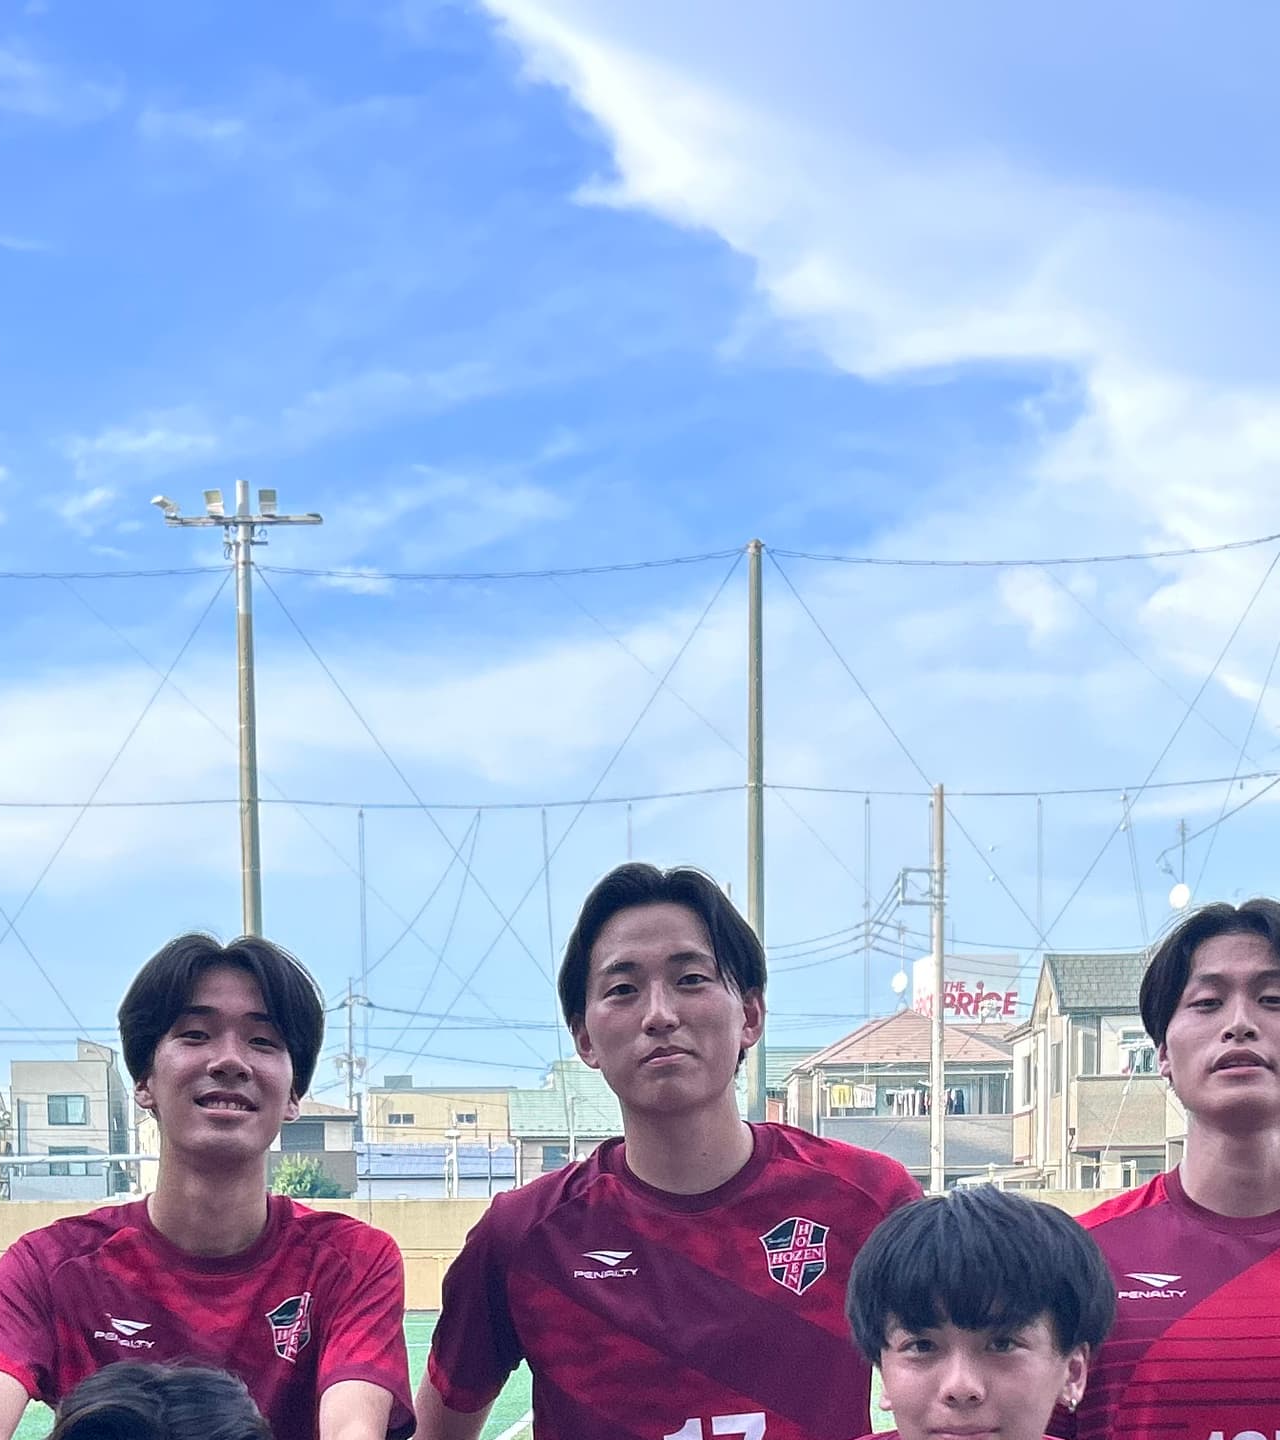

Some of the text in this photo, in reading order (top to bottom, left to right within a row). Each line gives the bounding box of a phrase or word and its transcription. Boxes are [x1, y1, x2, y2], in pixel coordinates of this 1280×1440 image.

[944, 981, 966, 992] THE
[772, 1248, 822, 1264] HOZEN
[574, 1268, 640, 1279] PENALTY
[1118, 1289, 1187, 1299] PENALTY
